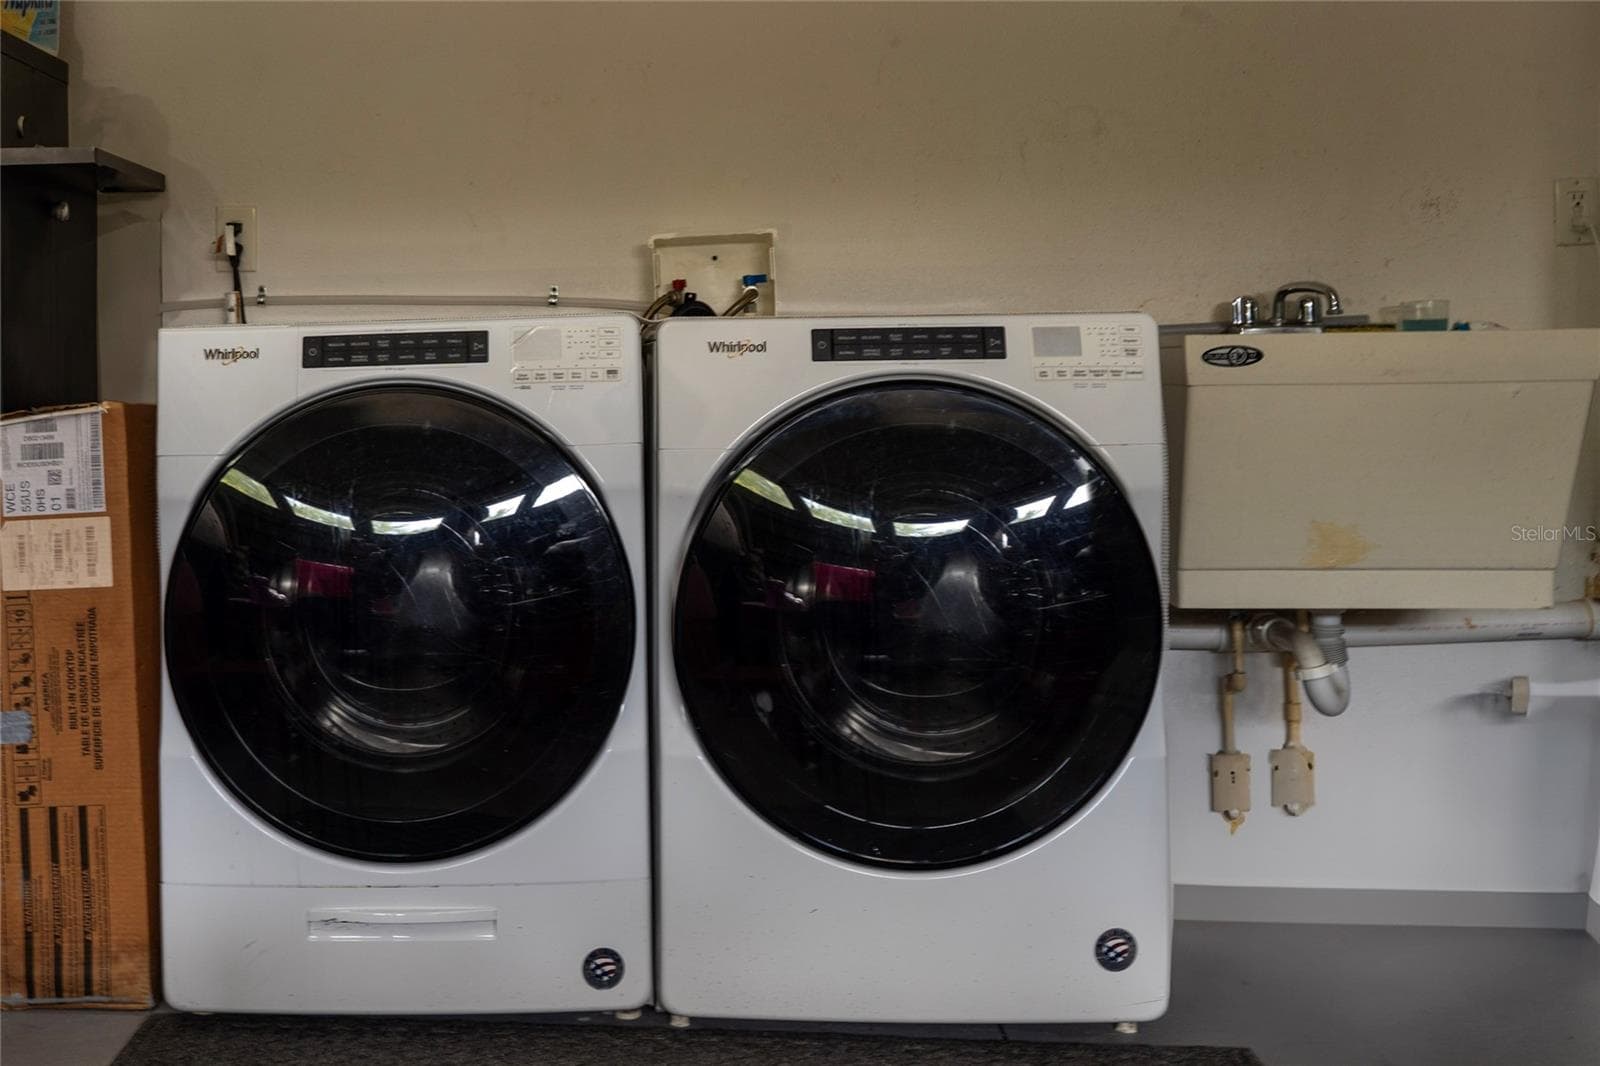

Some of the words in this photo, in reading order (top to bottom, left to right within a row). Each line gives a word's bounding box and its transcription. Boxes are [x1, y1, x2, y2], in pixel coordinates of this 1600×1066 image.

[203, 347, 260, 363] Whirlpool
[707, 341, 767, 357] Whirlpool
[6, 483, 16, 514] WCE
[87, 607, 98, 661] EMPOTRADA
[65, 649, 76, 690] COOKTOP
[78, 675, 89, 713] CUISSON
[67, 692, 78, 730] BUILT-IN
[79, 714, 90, 728] DE
[91, 705, 101, 717] DE
[81, 730, 91, 756] TABLE
[93, 719, 104, 770] SUPERFICIE
